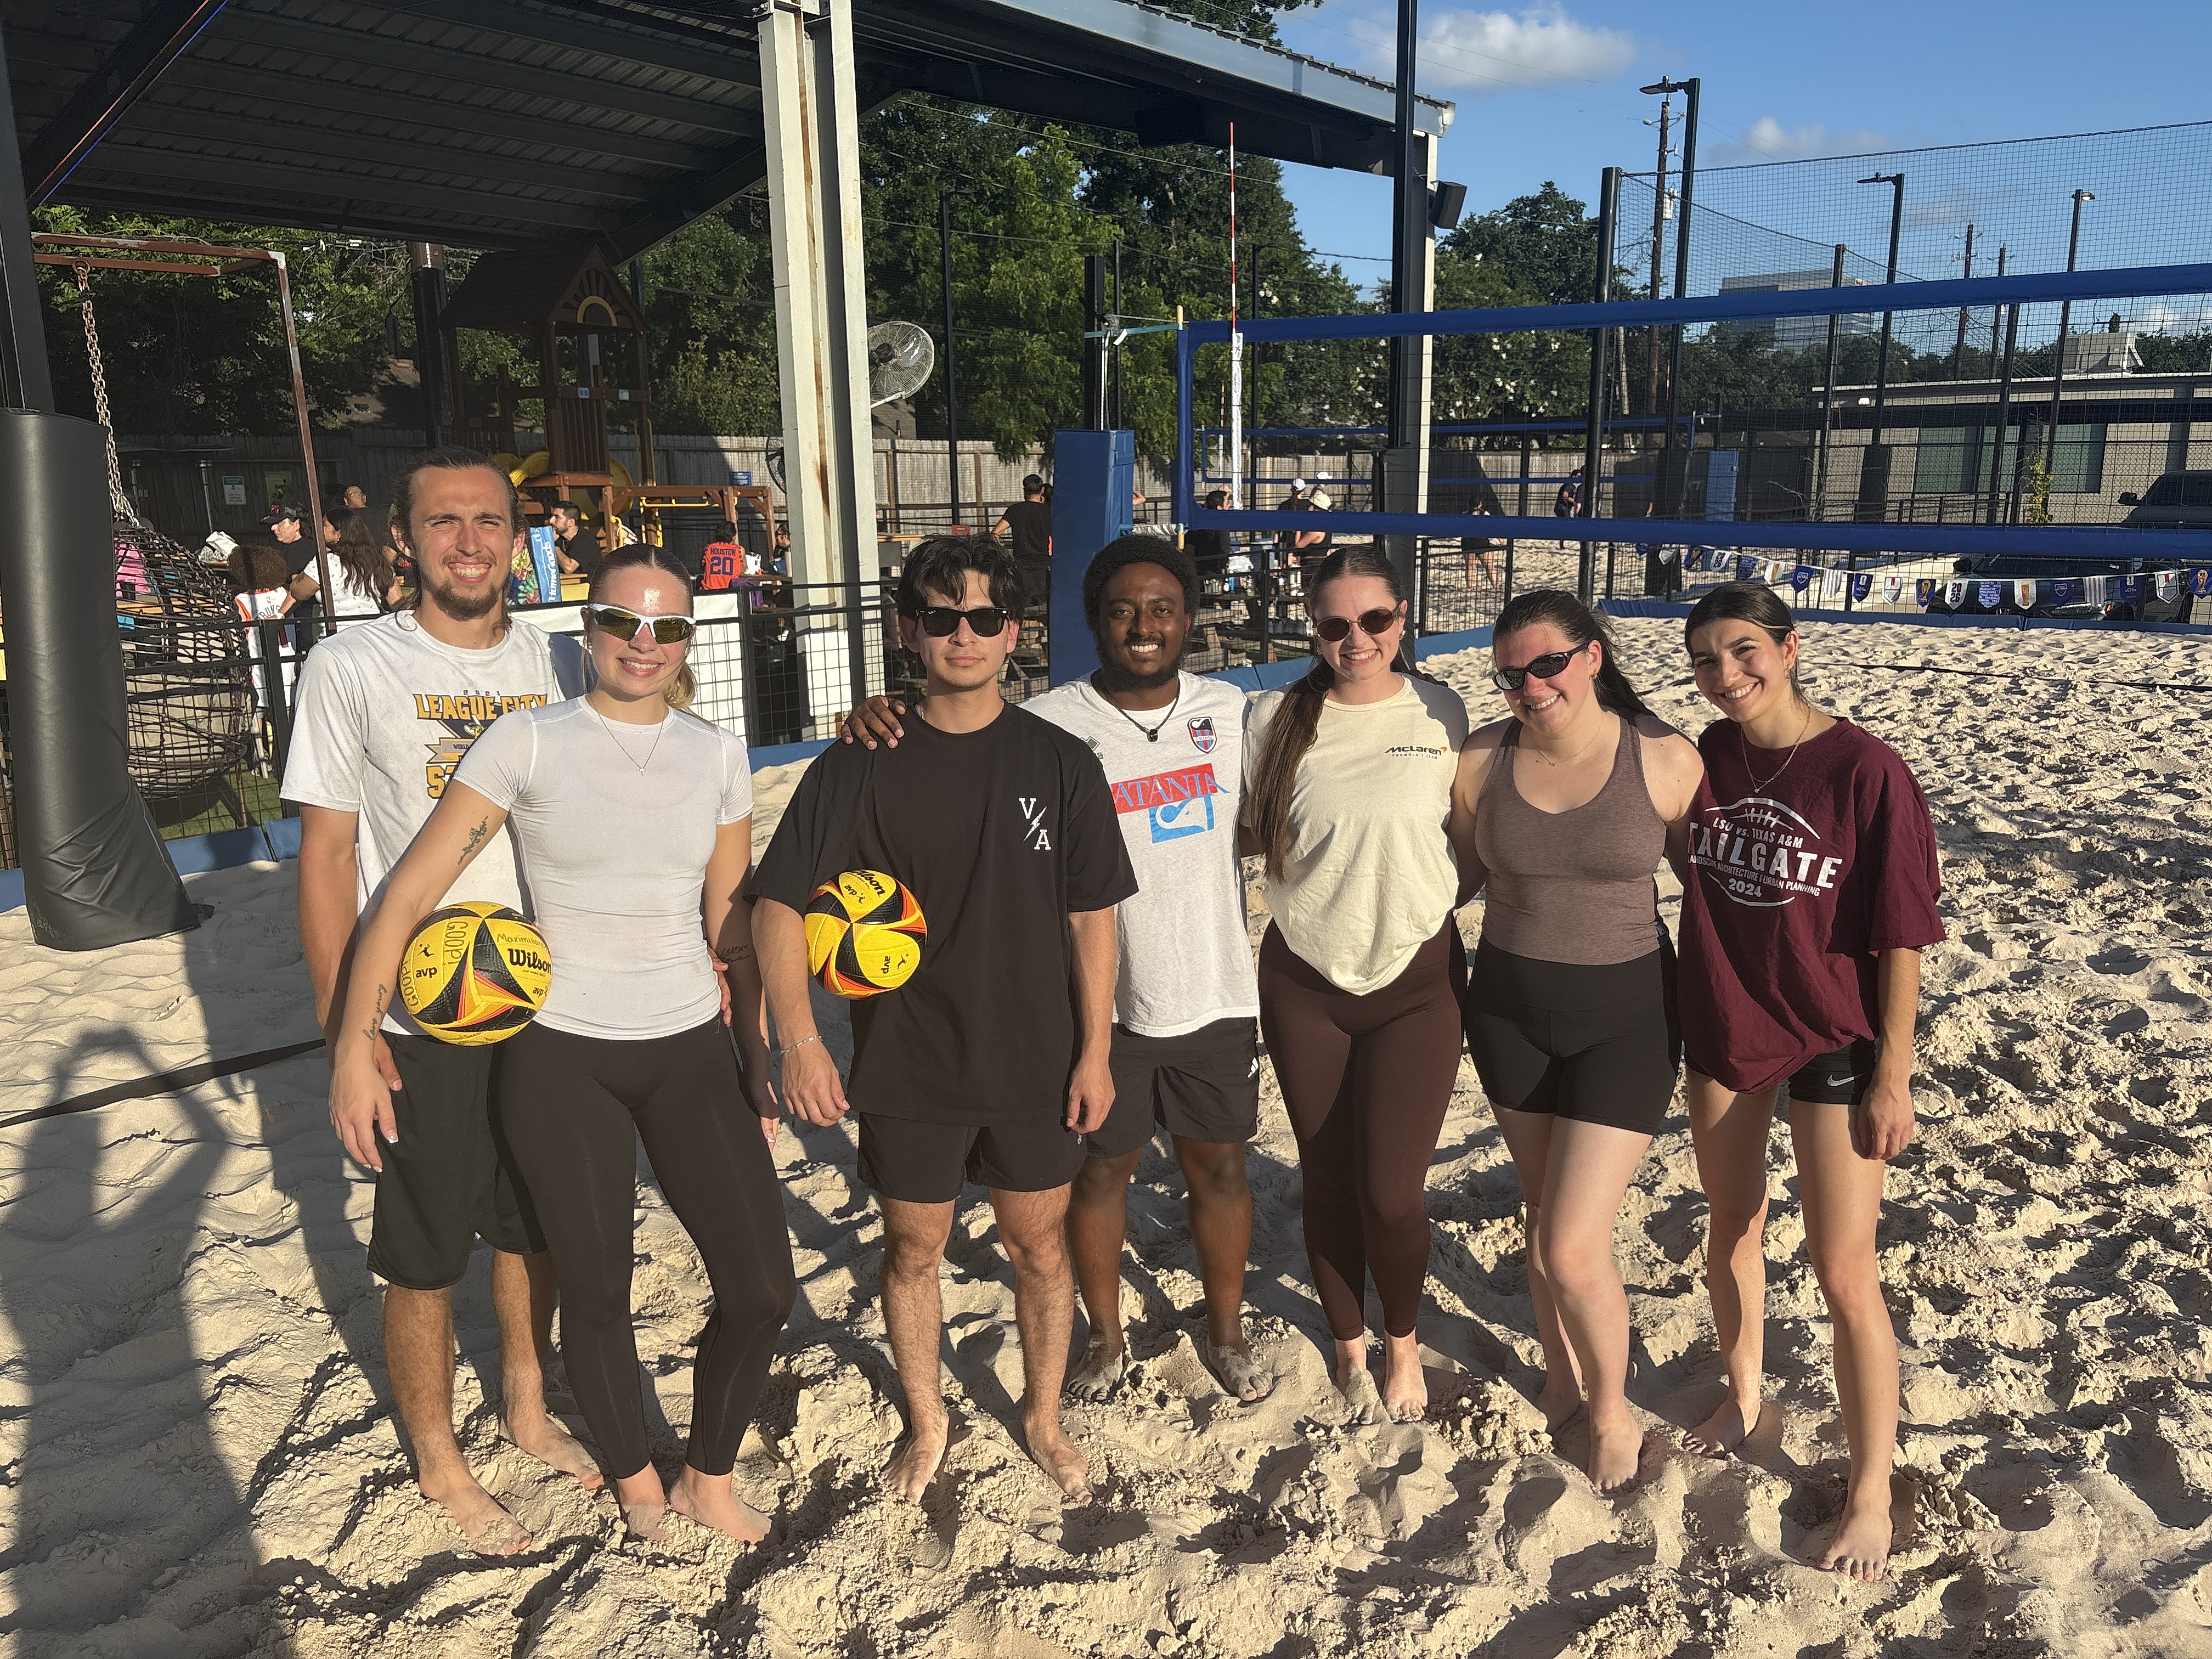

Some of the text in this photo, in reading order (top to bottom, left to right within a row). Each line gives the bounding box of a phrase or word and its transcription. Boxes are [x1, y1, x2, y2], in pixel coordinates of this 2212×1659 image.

[710, 556, 733, 575] 20
[1950, 592, 1961, 603] 26
[413, 693, 548, 720] LEAGUE CITY
[1384, 745, 1442, 756] McLaren
[1110, 772, 1231, 807] ATANIA
[1712, 817, 1735, 832] LSU
[1752, 828, 1776, 843] TEXAS
[1777, 834, 1804, 849] A&M
[1688, 822, 1843, 889] TAILGATE
[844, 884, 857, 895] avp
[1728, 878, 1762, 898] 2024
[1763, 875, 1784, 889] URBAN
[1785, 881, 1821, 897] PLANNING
[507, 948, 552, 975] Wilson
[880, 955, 891, 974] avp
[415, 967, 438, 979] avp
[532, 987, 544, 998] avp
